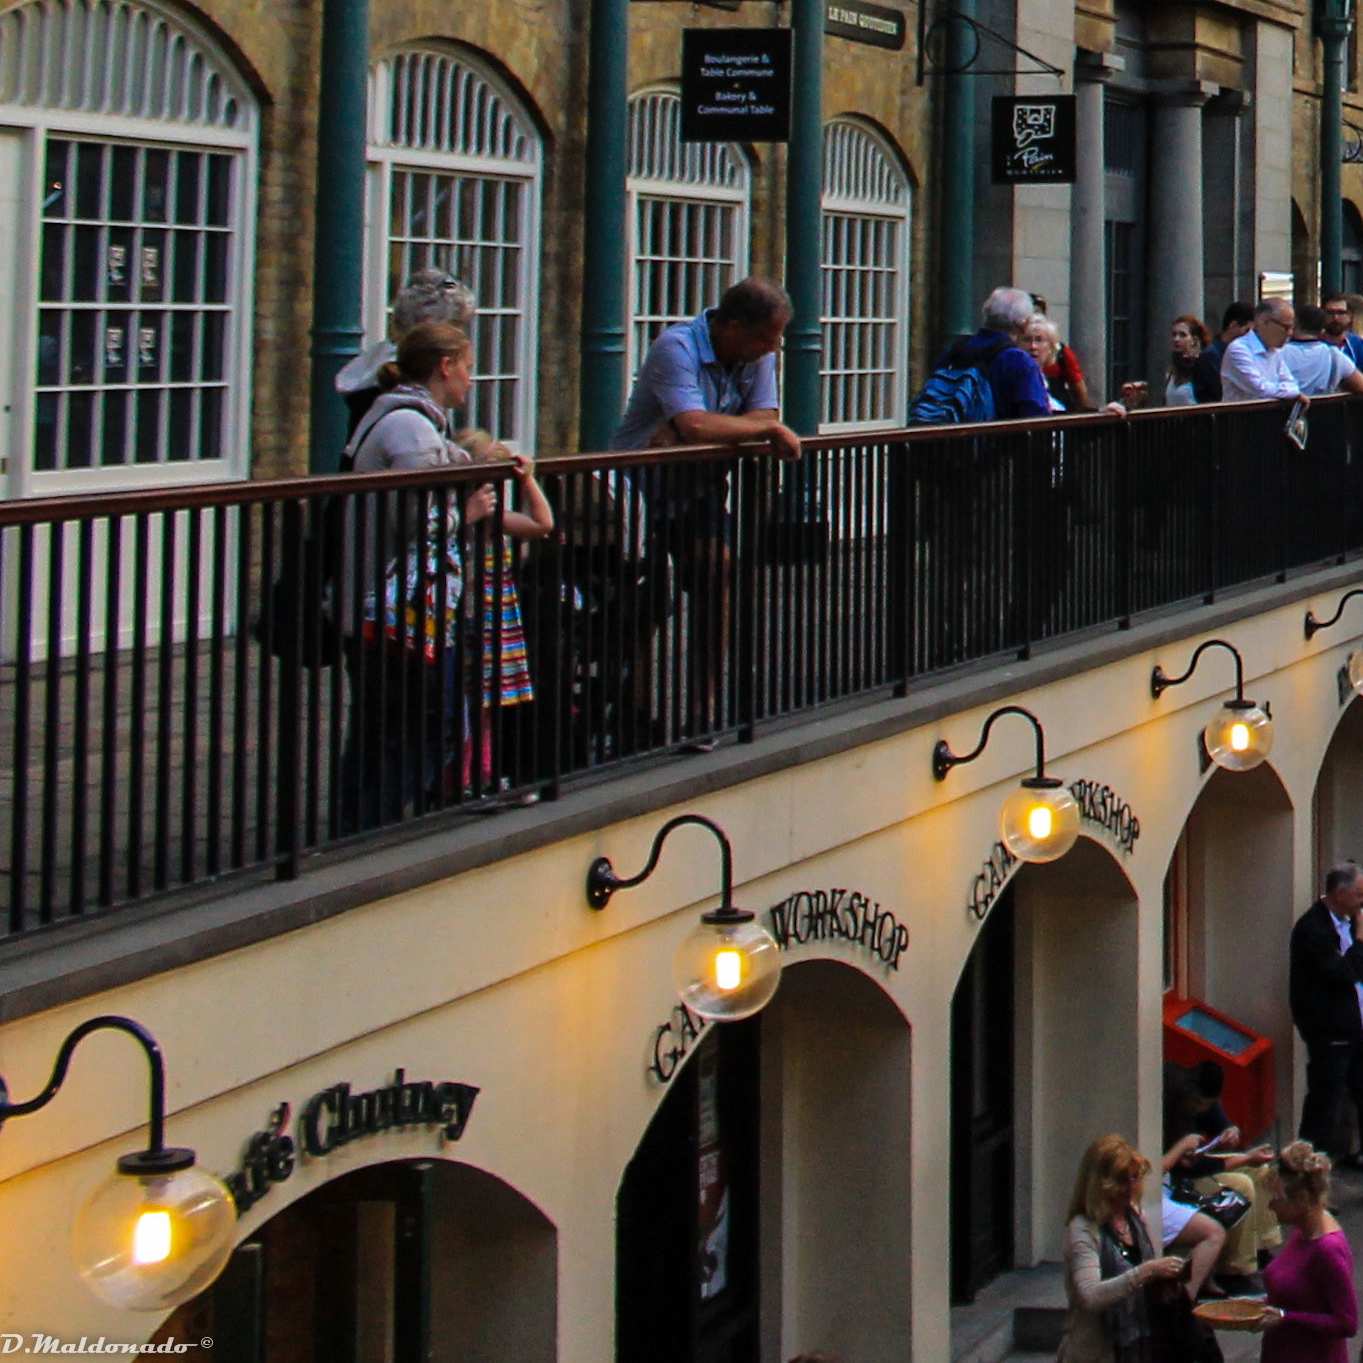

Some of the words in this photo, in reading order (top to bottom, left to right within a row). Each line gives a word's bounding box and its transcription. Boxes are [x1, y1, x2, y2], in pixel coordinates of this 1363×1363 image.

[704, 54, 759, 66] Boulangerie
[701, 67, 725, 77] Table
[715, 91, 746, 102] Bakery
[697, 104, 749, 114] Communal
[750, 105, 775, 114] Table
[770, 888, 909, 971] WORKSHOP
[303, 1068, 480, 1156] Chutney
